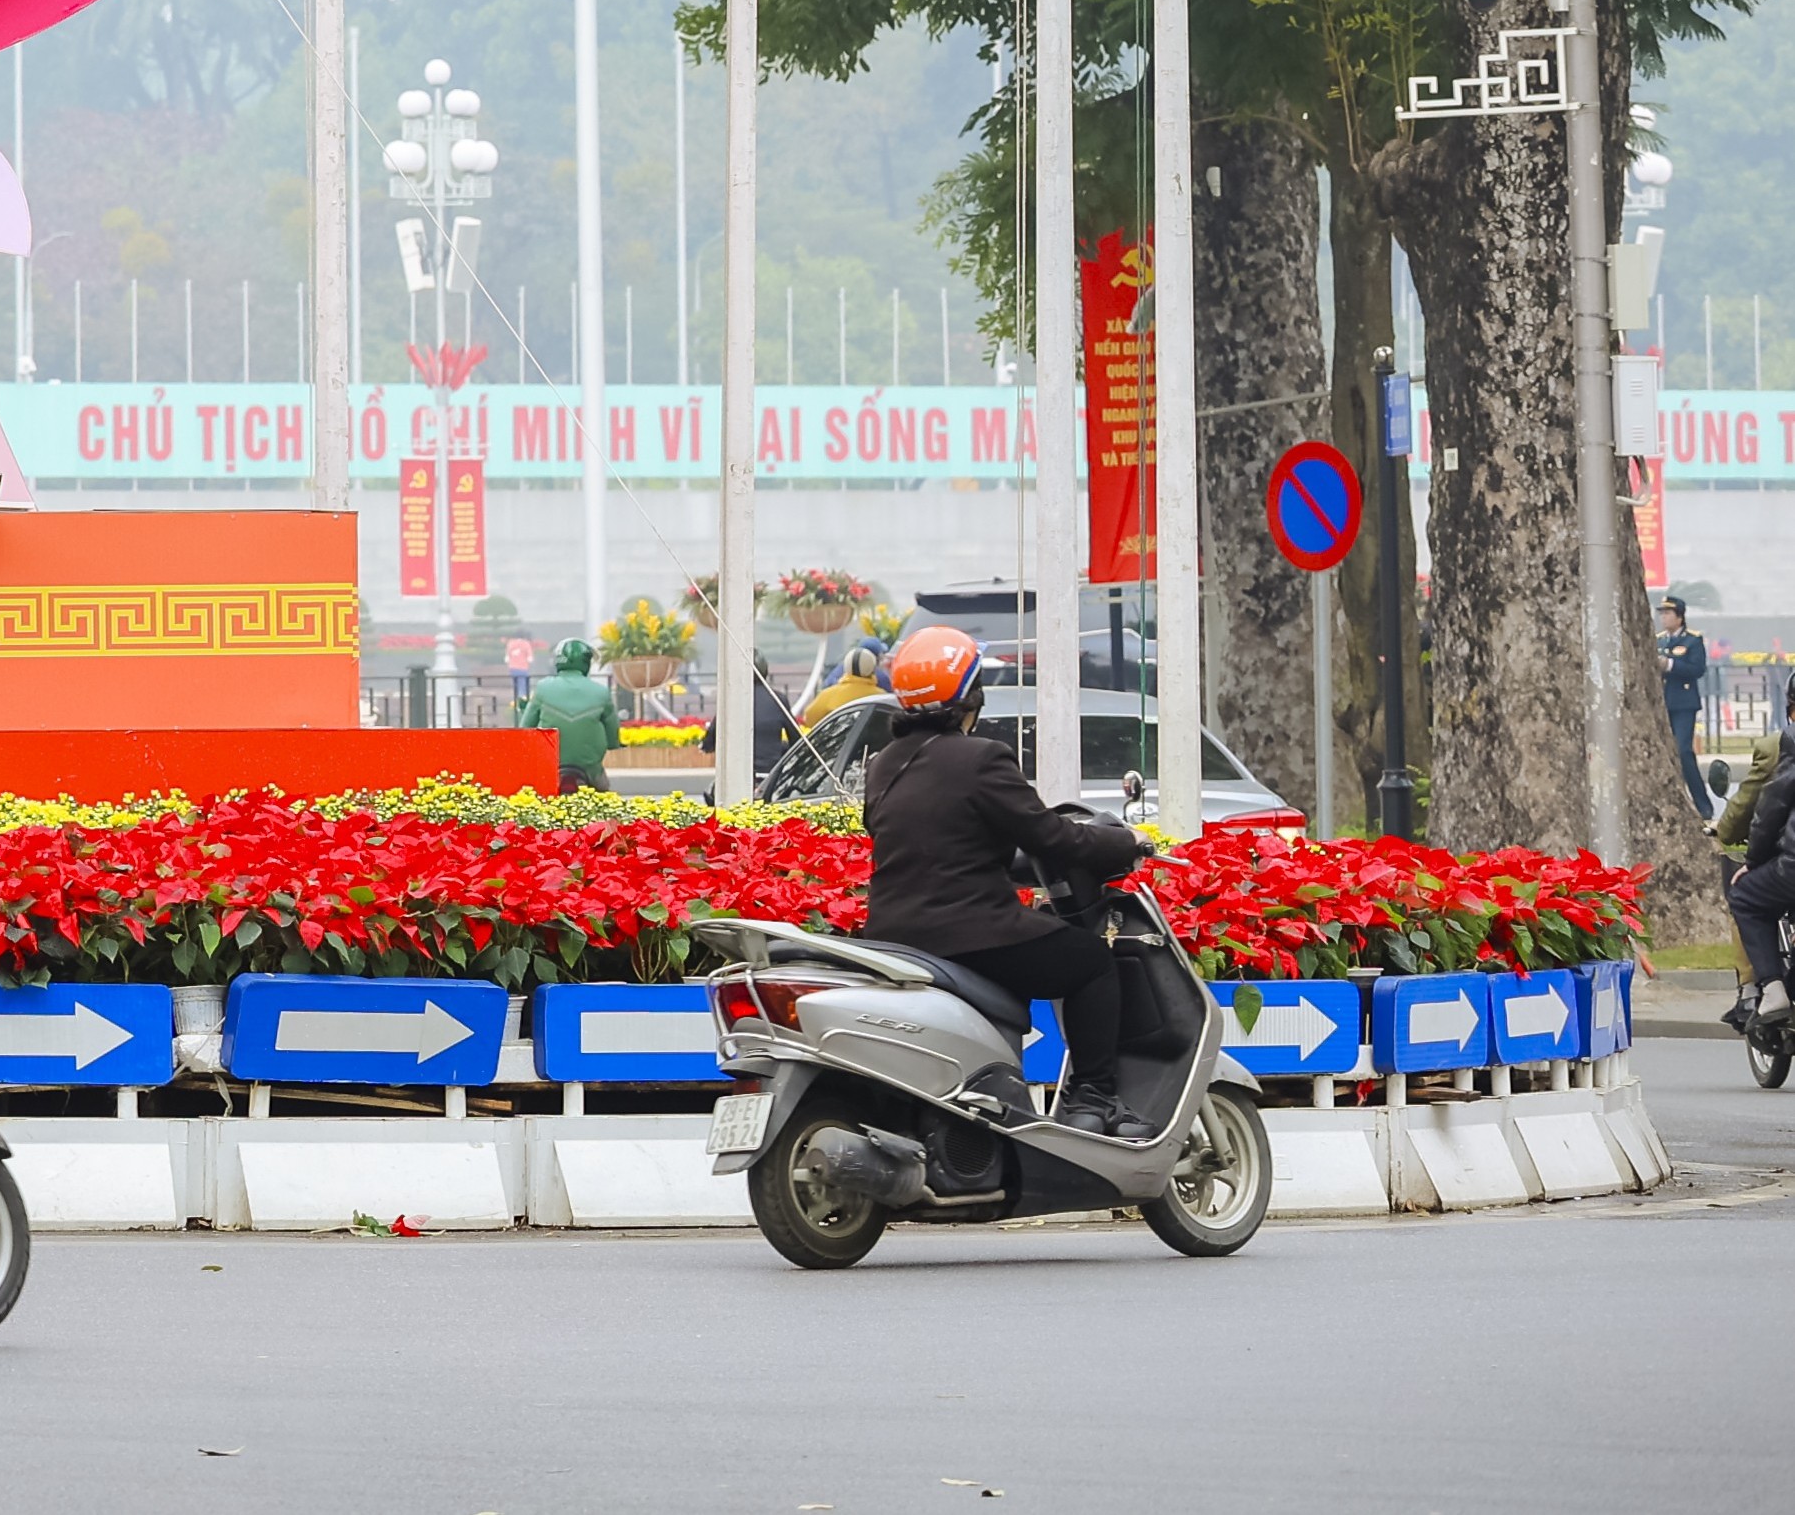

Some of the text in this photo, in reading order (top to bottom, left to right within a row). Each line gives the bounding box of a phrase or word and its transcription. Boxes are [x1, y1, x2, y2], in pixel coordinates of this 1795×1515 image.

[77, 387, 173, 462] CHỦ
[196, 404, 303, 473] TỊCH
[347, 385, 387, 462] Ồ
[659, 395, 703, 463] VĨ
[757, 406, 801, 474] ẠI
[824, 386, 950, 463] SỐNG
[971, 397, 1037, 463] MÃ
[1658, 398, 1759, 464] ÚNG
